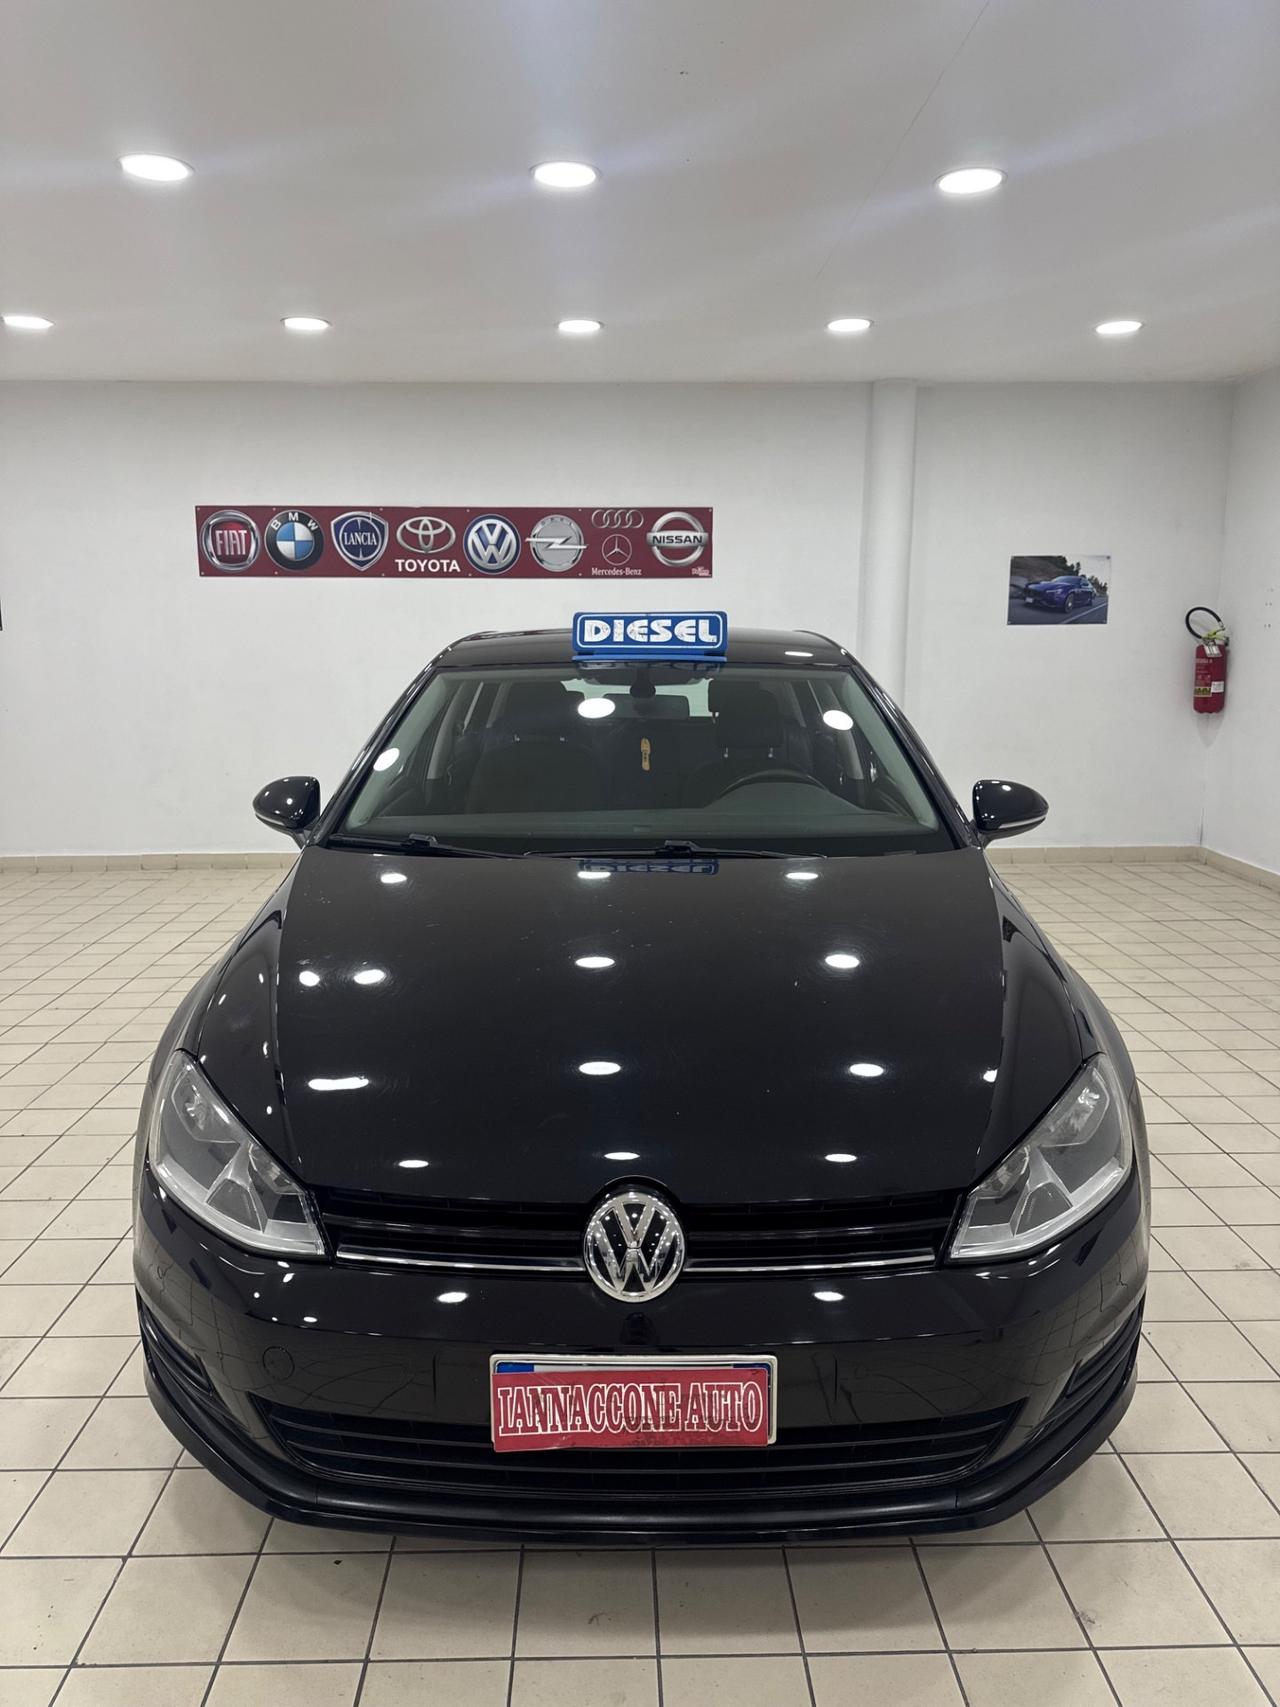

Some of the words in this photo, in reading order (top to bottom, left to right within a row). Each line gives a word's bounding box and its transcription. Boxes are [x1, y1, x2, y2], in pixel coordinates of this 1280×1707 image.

[270, 512, 319, 532] BMW
[214, 530, 248, 556] FIAT
[343, 532, 378, 546] LANCIA
[652, 535, 703, 544] NISSAN
[395, 559, 461, 572] TOYOTA
[591, 567, 642, 576] Mercedes-Benz
[584, 619, 717, 643] DIESEL
[498, 1383, 682, 1436] IANNACCONE
[684, 1381, 763, 1432] AUTO
